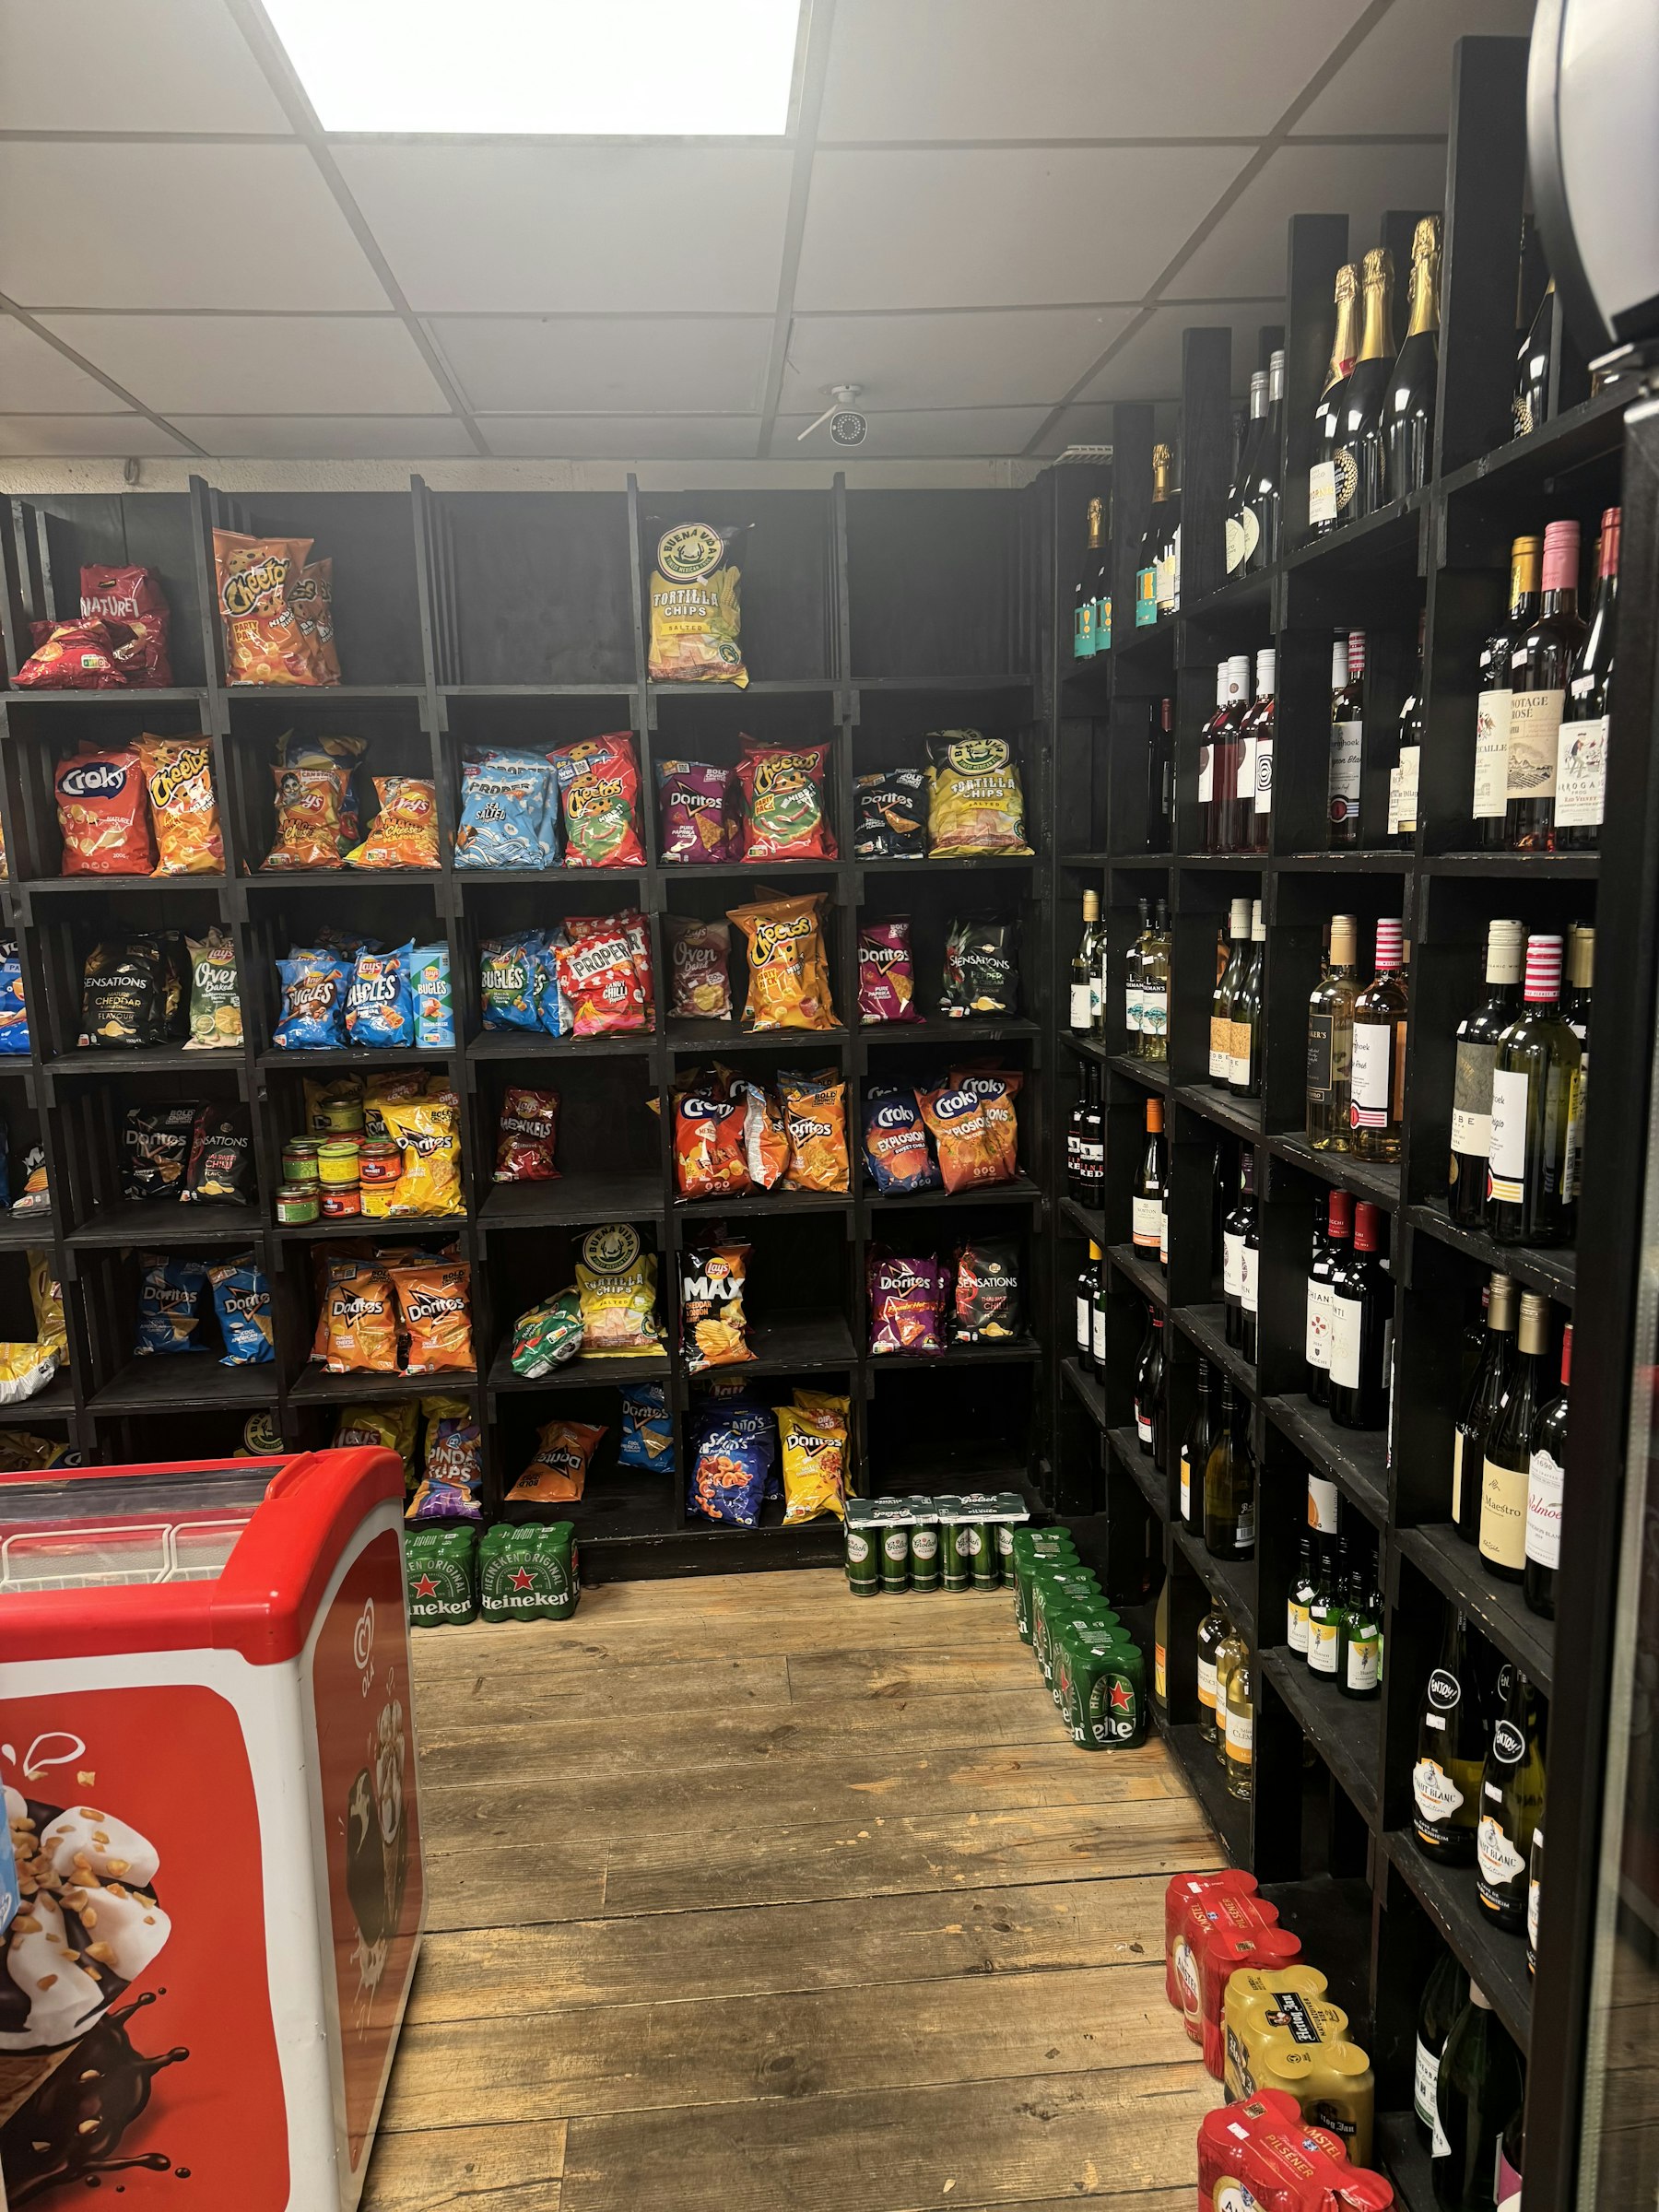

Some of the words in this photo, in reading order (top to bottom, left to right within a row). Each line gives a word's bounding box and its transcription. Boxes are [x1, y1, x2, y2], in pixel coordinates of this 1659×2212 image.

[664, 528, 698, 552] BUENA
[653, 589, 719, 606] TORTILLA
[665, 606, 707, 617] CHIPS
[233, 620, 259, 632] PARTY
[62, 766, 124, 795] Croky
[756, 753, 818, 794] Cheetos
[951, 777, 1016, 794] TORTILLA
[963, 789, 1004, 799] CHIPS
[569, 779, 623, 820] Cheetos
[670, 792, 724, 809] Doritos
[755, 794, 775, 808] PARTY
[861, 793, 913, 809] Doritos
[476, 809, 506, 821] SALTED
[751, 918, 811, 968] Cheetos
[572, 942, 632, 978] PROPER
[673, 942, 717, 966] Oven
[859, 947, 910, 963] Doritos
[206, 980, 234, 993] Baked
[418, 981, 447, 995] BUGLES
[482, 969, 524, 990] BUGLES
[602, 986, 629, 999] CHILLI
[95, 996, 142, 1007] CHEDDAR
[98, 1012, 135, 1020] FLAVOUR
[963, 1077, 1006, 1094] Croky
[935, 1090, 979, 1119] Croky
[878, 1105, 915, 1128] Croky
[125, 1130, 187, 1147] Doritos
[395, 1135, 453, 1151] Doritos
[895, 1144, 913, 1154] SWEET
[1080, 1170, 1105, 1178] RED
[589, 1225, 616, 1253] BUENA
[618, 1227, 635, 1246] VIDA
[442, 1271, 465, 1280] BOLD
[707, 1262, 729, 1276] Lay's
[596, 1285, 632, 1297] CHIPS
[683, 1277, 746, 1301] MAX
[880, 1277, 931, 1289] Doritos
[957, 1277, 1018, 1288] SENSATIONS
[143, 1286, 197, 1303] Doritos
[333, 1300, 383, 1316] Doritos
[408, 1297, 465, 1323] Doritos
[686, 1300, 712, 1310] CHEDDAR
[689, 1308, 709, 1317] ONION
[622, 1400, 669, 1420] Doritos
[960, 1495, 998, 1505] Grolsch
[1485, 1493, 1522, 1517] Maestro
[427, 1559, 466, 1594] ORIGINAL
[484, 1554, 520, 1591] HEINEKEN
[524, 1552, 559, 1586] ORIGINAL
[481, 1592, 570, 1611] Heineken
[361, 1660, 375, 1699] OLA
[1430, 1678, 1458, 1700] ENJOY!
[1496, 1730, 1522, 1754] ENJOY!
[1430, 1786, 1456, 1804] BLANC
[1490, 1849, 1517, 1867] BLANC
[1191, 1903, 1212, 1934] AMSTEL
[1221, 1898, 1248, 1929] PILSENER
[1177, 1957, 1197, 1996] AMSTEL
[1282, 1994, 1302, 2013] Jan
[1289, 2011, 1316, 2042] Hertog
[1335, 2122, 1356, 2133] Jan
[1300, 2124, 1342, 2160] AMSTEL
[1265, 2134, 1314, 2178] PILSENER
